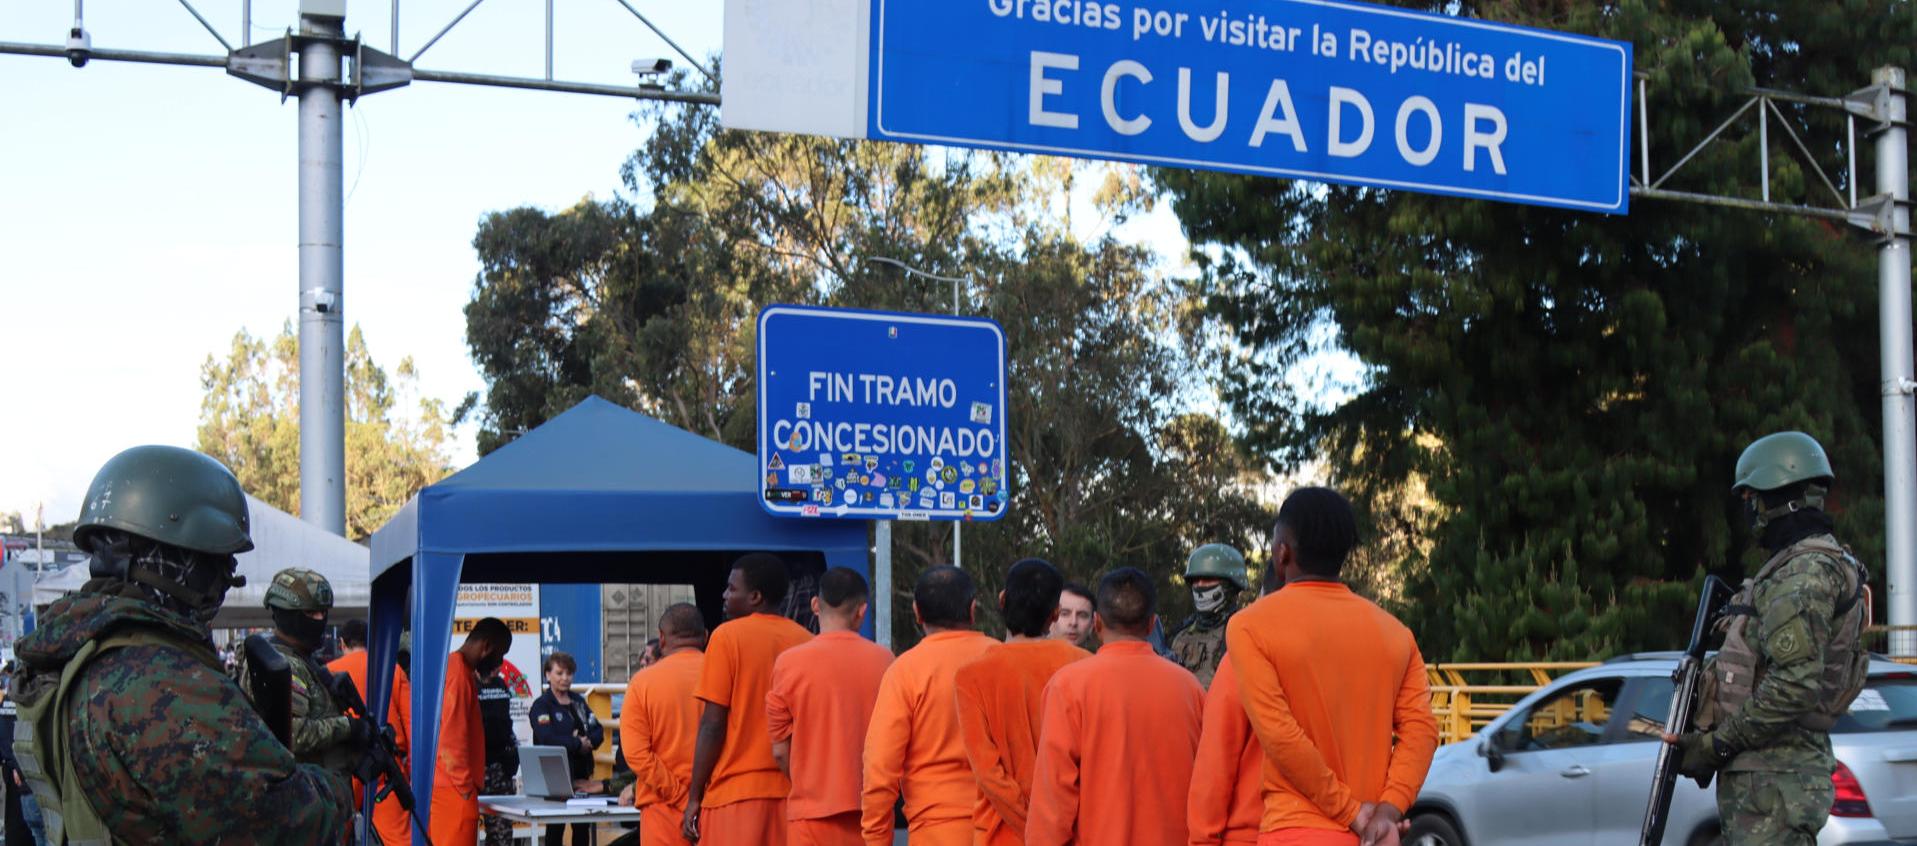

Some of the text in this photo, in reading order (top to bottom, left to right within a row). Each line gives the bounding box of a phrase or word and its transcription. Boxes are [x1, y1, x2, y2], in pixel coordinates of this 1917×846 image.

[1133, 7, 1189, 41] por
[1200, 10, 1302, 51] visitar
[1312, 23, 1337, 58] la
[1349, 27, 1496, 79] República
[1505, 52, 1545, 87] del
[1029, 50, 1508, 176] ECUADOR
[809, 371, 957, 408] FIN TRAMO
[773, 419, 994, 458] CONCESIONADO
[457, 592, 533, 601] GROPECUARIOS
[508, 620, 529, 632] ER:
